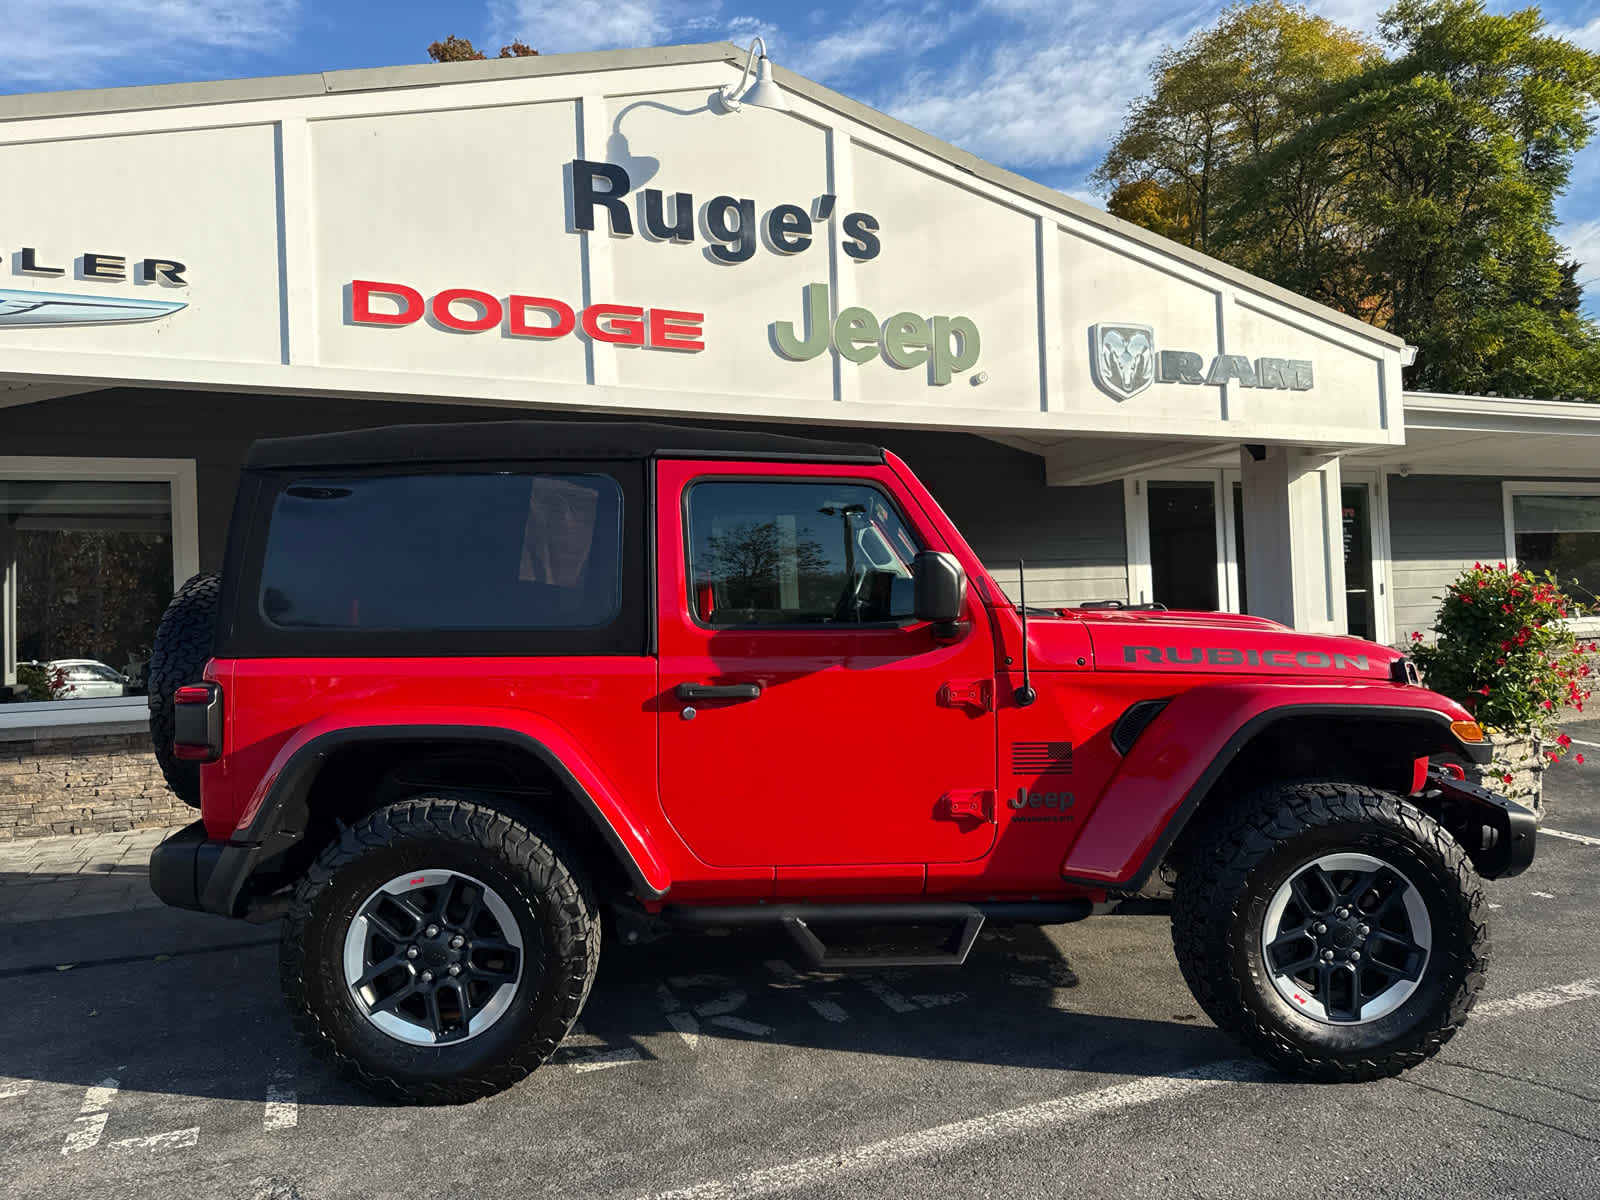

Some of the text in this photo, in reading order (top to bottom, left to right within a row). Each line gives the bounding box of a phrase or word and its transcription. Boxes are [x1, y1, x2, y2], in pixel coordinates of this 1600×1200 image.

[572, 159, 881, 263] Ruge's
[0, 247, 188, 285] LER
[352, 279, 705, 350] DODGE
[775, 283, 980, 384] Jeep
[1158, 350, 1313, 391] RAM
[1122, 645, 1370, 671] RUBICON
[1007, 787, 1075, 812] Jeep
